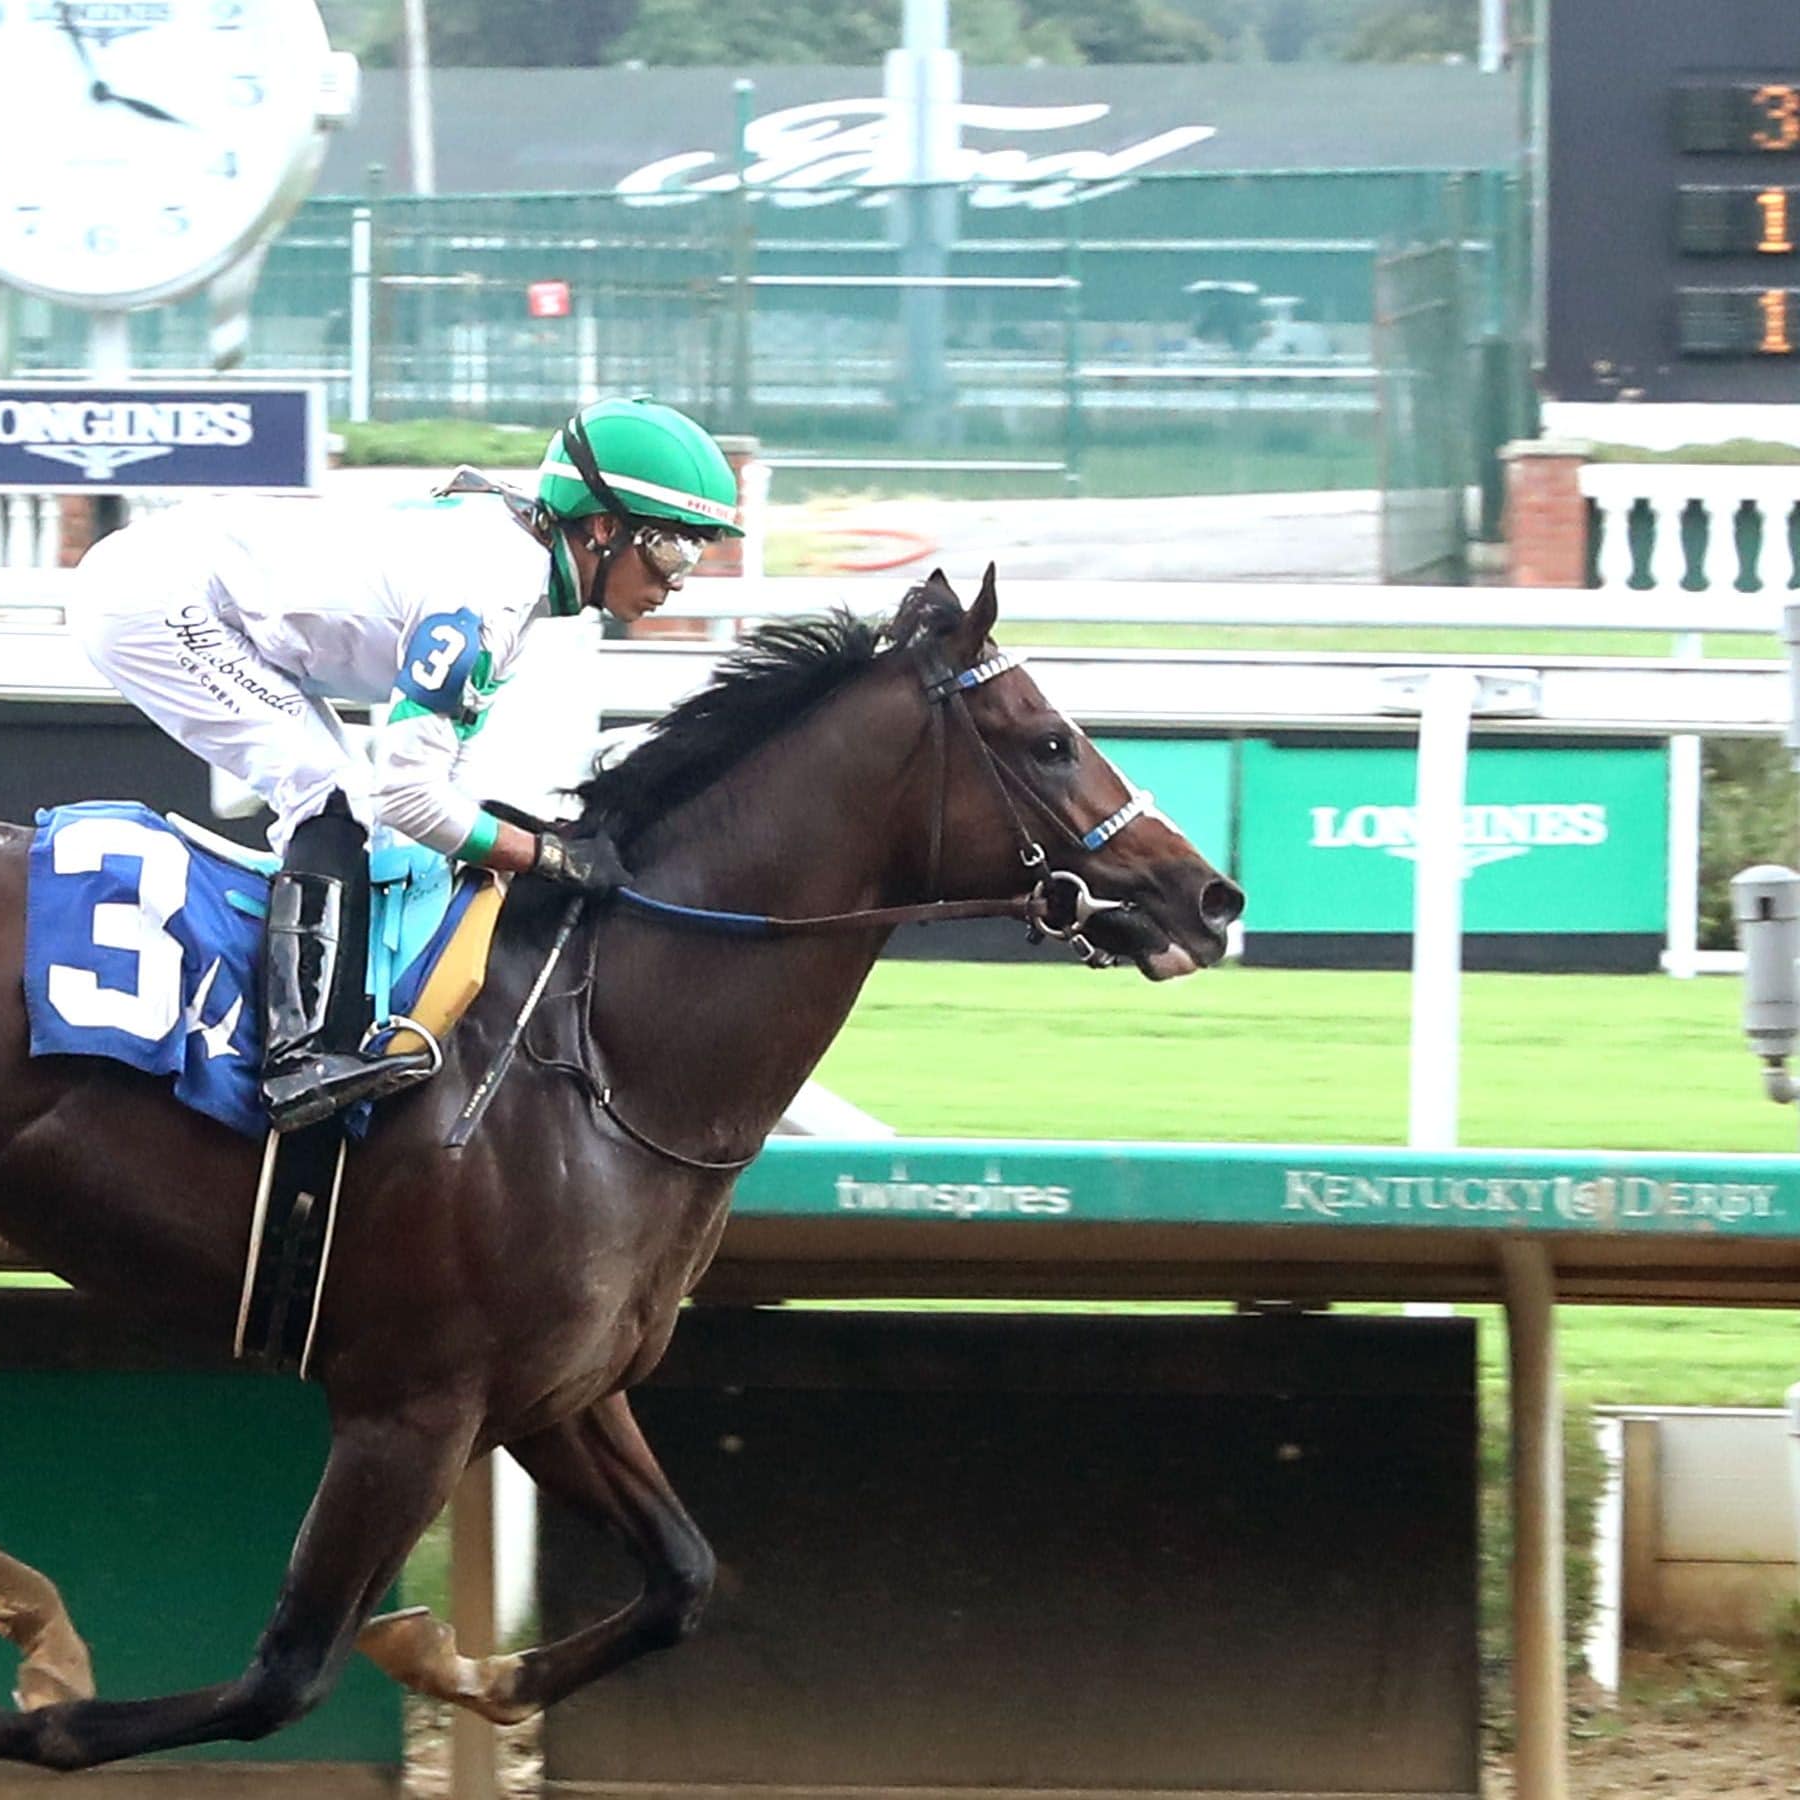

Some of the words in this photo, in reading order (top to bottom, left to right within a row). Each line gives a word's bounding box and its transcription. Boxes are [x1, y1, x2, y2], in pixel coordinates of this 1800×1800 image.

[1752, 84, 1800, 150] 3
[1756, 186, 1793, 253] 1
[1756, 287, 1793, 353] 1
[411, 624, 467, 691] 3
[1307, 804, 1608, 848] LONINES
[48, 816, 190, 1042] 3
[834, 1160, 1072, 1218] twinspires
[1282, 1170, 1550, 1217] KENTUCKY
[1621, 1176, 1780, 1223] DERBY
